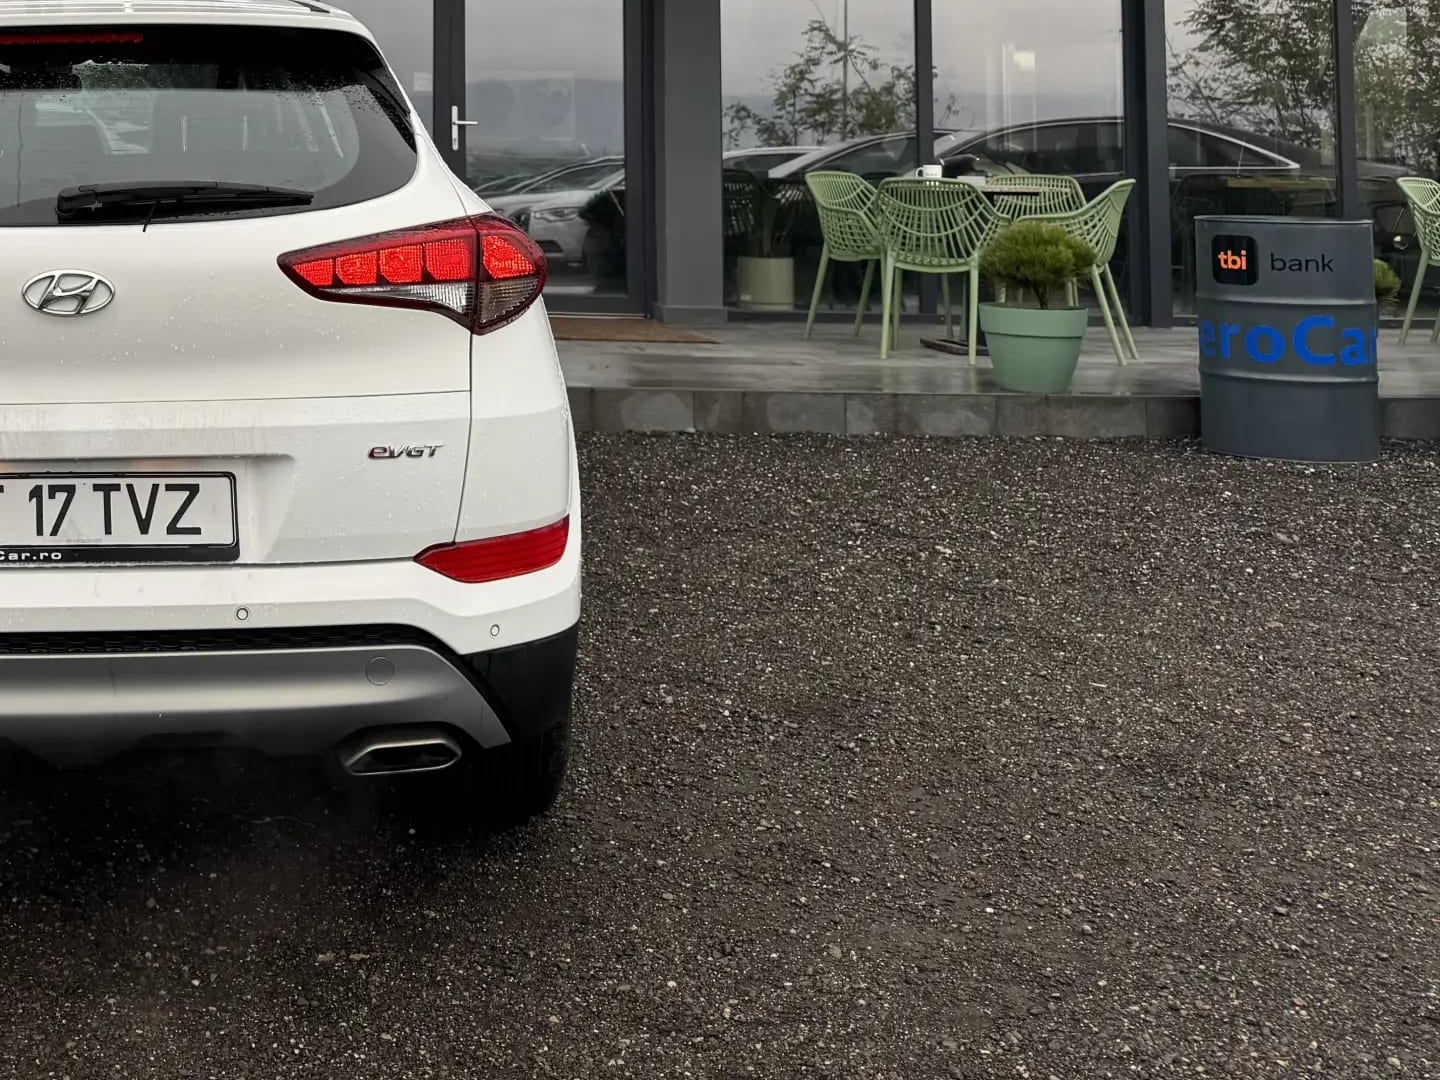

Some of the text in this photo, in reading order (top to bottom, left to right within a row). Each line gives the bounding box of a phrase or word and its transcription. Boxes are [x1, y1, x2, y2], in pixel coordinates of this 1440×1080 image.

[1217, 250, 1335, 273] tbi bank
[28, 483, 77, 537] 17
[92, 483, 202, 536] TVZ
